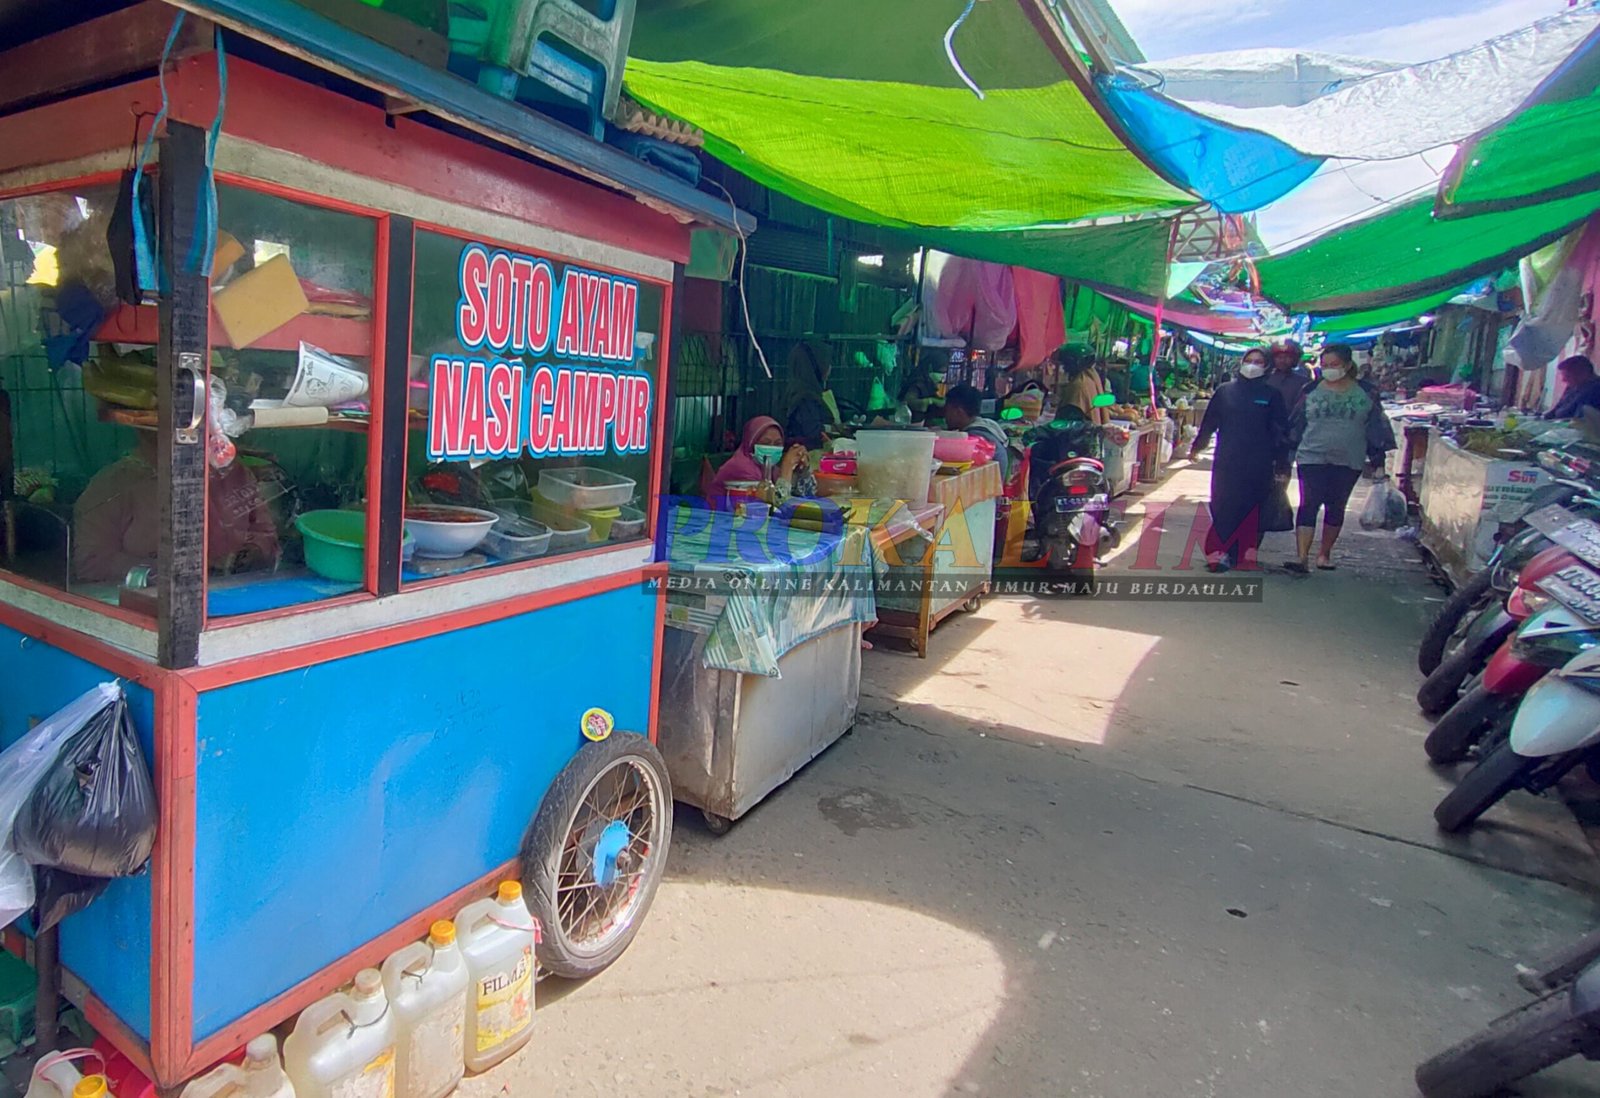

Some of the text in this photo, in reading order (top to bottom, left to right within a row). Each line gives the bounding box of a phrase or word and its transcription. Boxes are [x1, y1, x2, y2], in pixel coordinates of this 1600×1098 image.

[460, 247, 637, 361] SOTO AYAM
[430, 359, 649, 456] NASI CAMPUR
